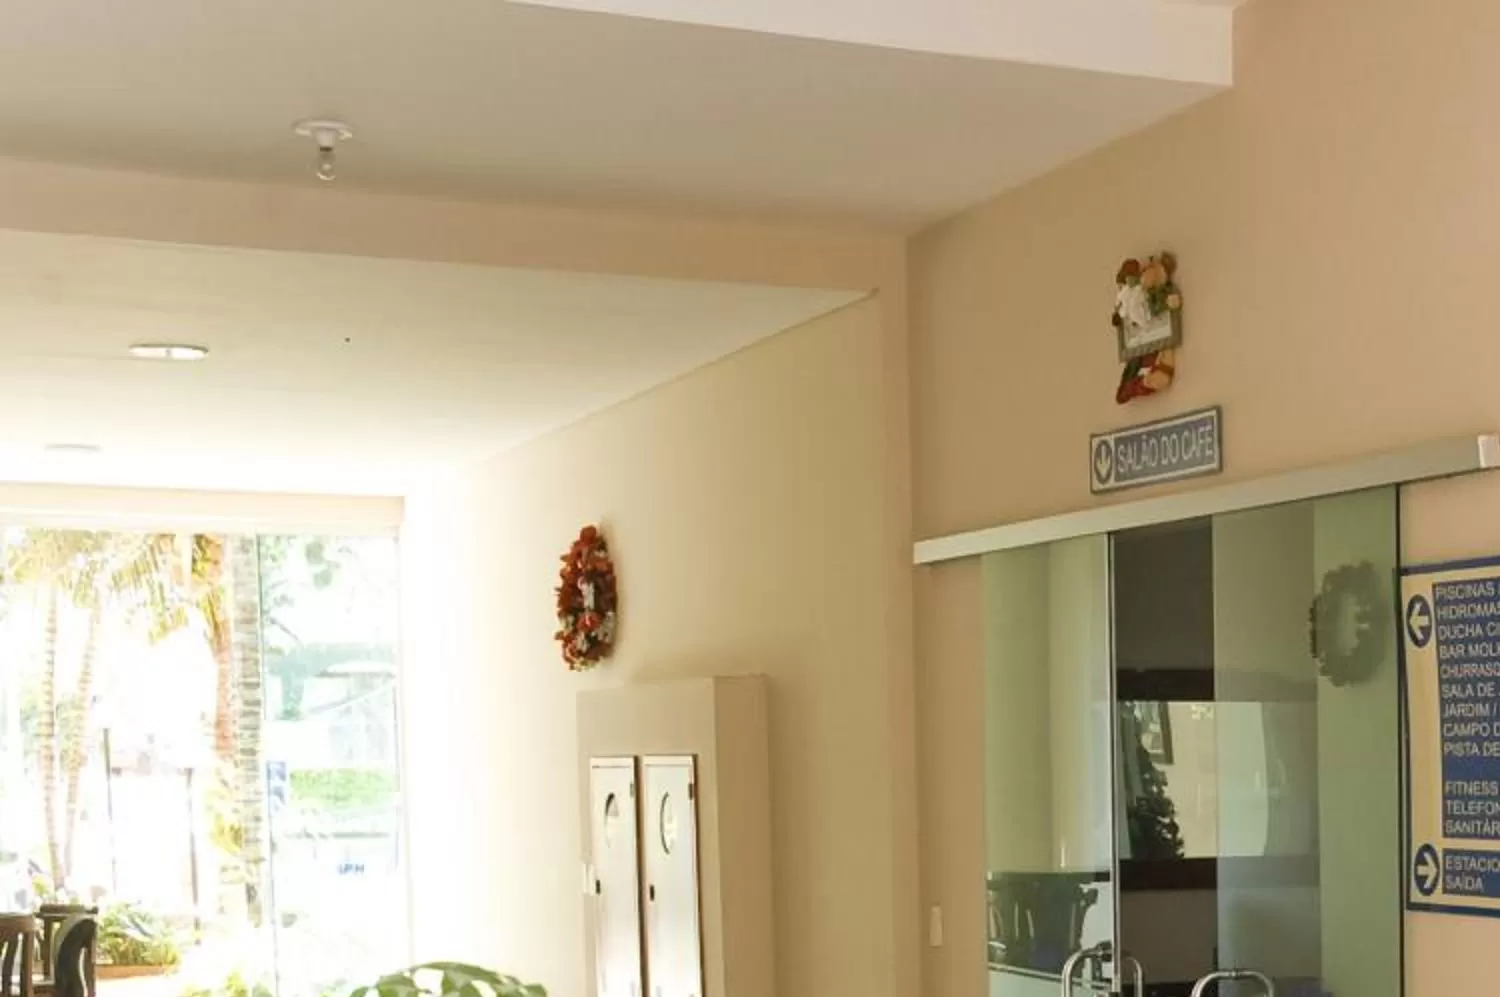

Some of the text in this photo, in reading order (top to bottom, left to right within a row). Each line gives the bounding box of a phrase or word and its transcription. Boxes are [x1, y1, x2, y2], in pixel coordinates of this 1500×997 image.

[1160, 431, 1180, 466] DO
[1435, 582, 1495, 600] PISCINAS
[1438, 624, 1484, 640] DUCHA
[1439, 643, 1465, 659] BAR
[1441, 683, 1475, 698] SALA
[1476, 681, 1497, 697] DE
[1444, 702, 1490, 718] JARDIM
[1443, 722, 1491, 737] CAMPO
[1443, 741, 1480, 757] PISTA
[1445, 780, 1499, 796] FITNESS
